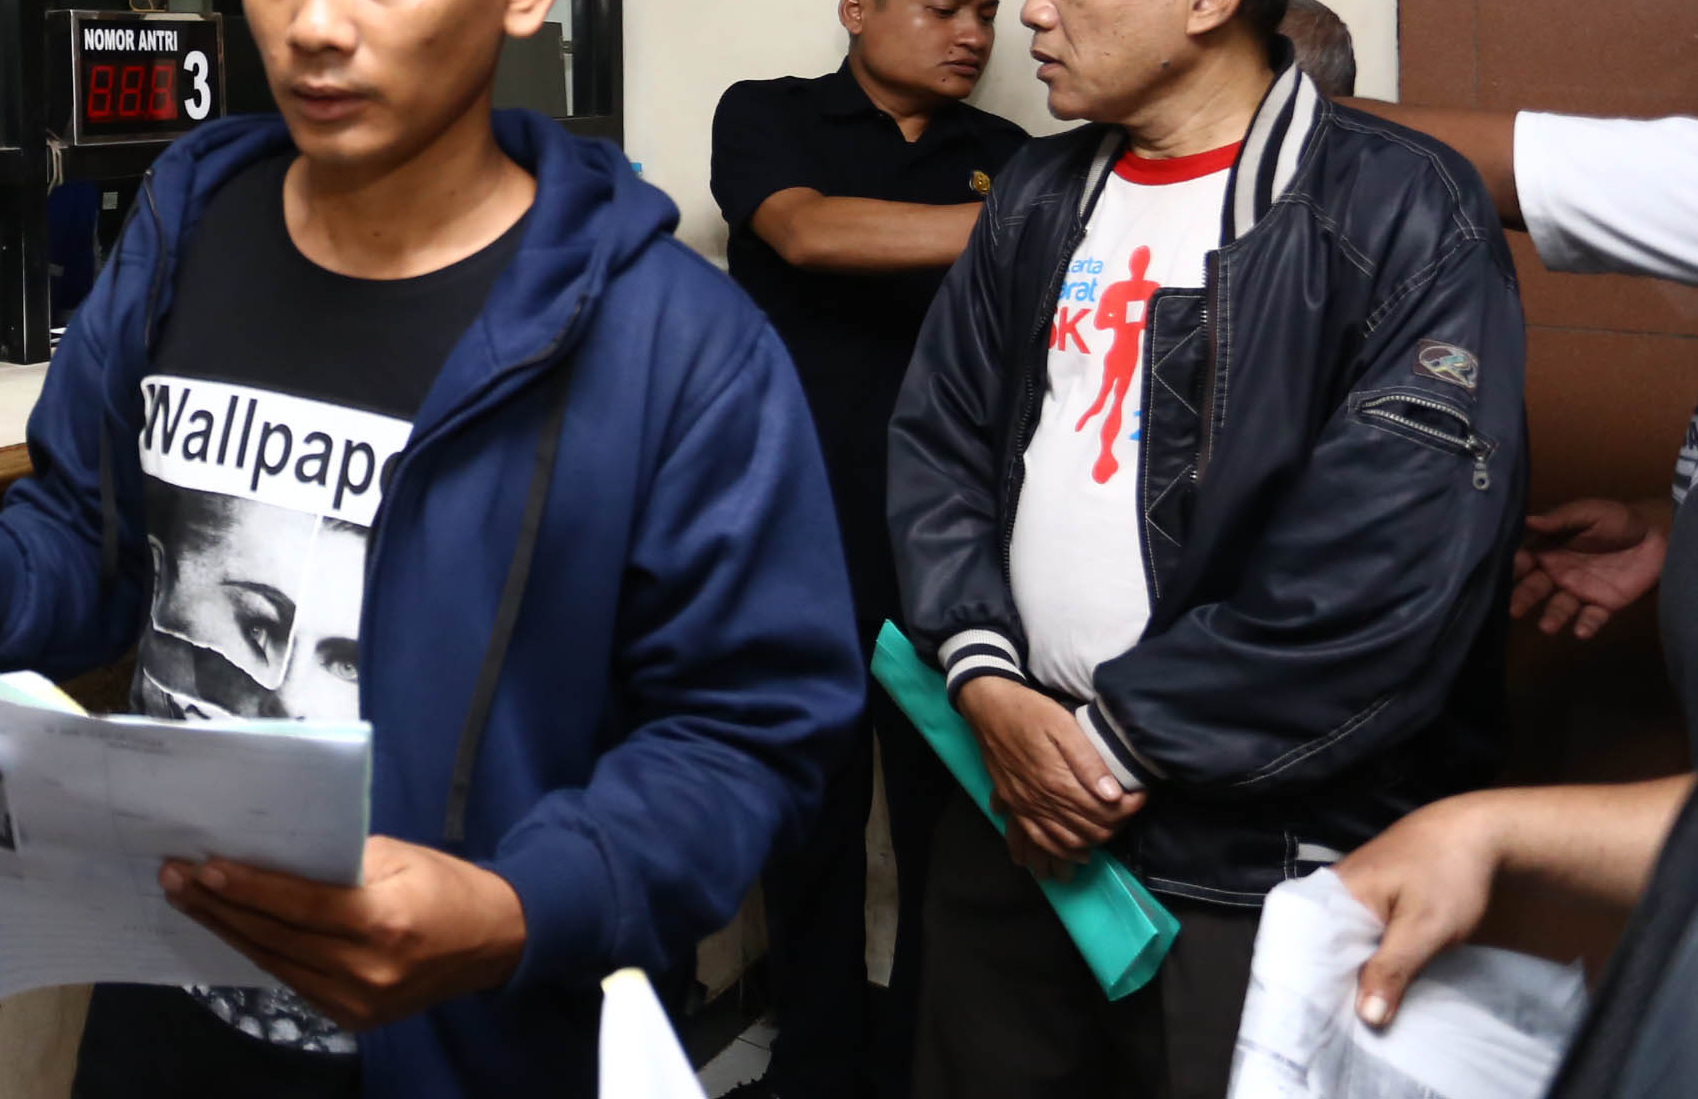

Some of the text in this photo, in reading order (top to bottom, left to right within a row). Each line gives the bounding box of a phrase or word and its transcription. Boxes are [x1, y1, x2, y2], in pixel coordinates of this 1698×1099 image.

[84, 28, 179, 52] NOMOR ANTRI
[183, 50, 212, 120] 3
[1067, 256, 1104, 275] arta
